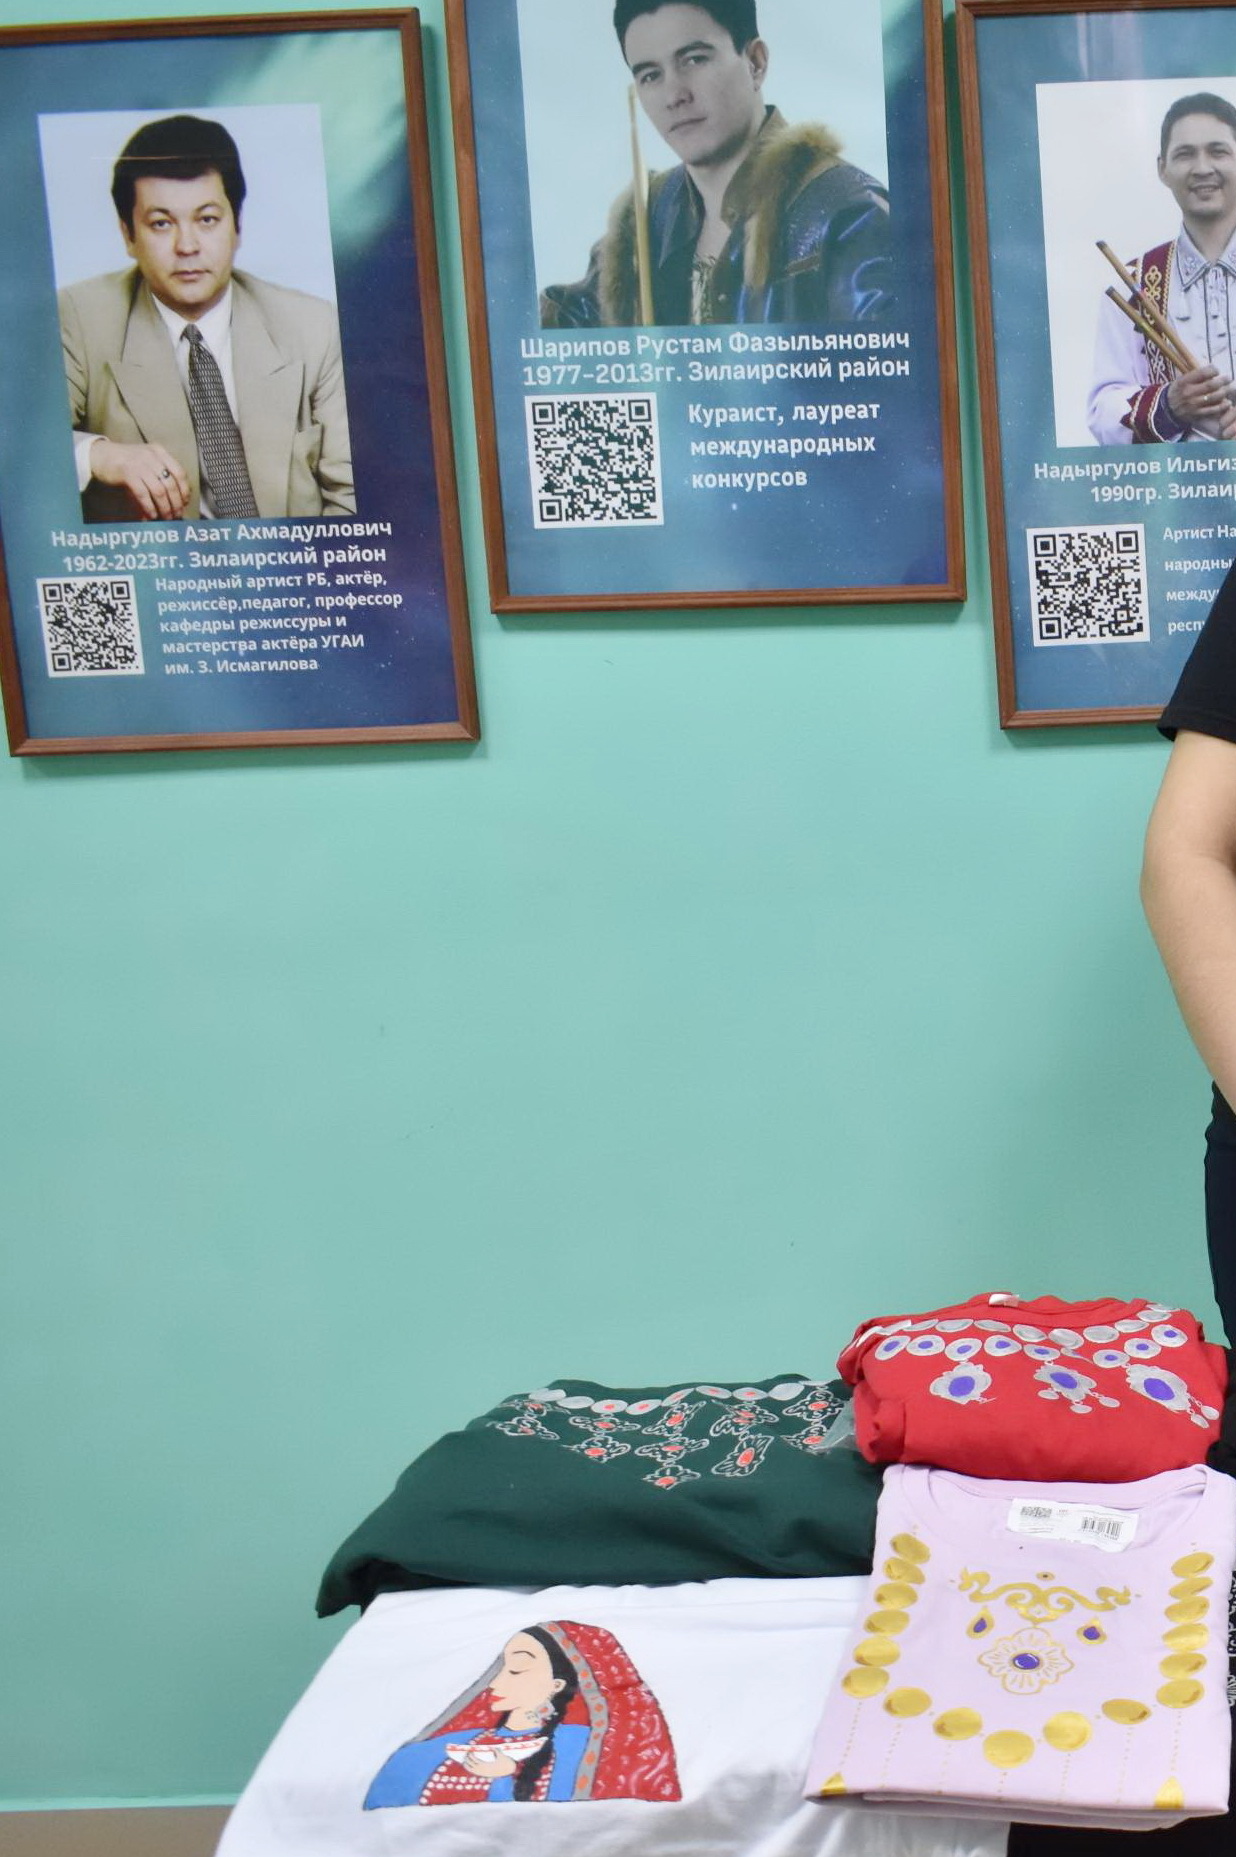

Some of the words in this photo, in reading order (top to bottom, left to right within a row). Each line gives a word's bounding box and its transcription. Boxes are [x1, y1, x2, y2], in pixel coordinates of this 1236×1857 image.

[520, 337, 631, 362] Шарипов
[637, 335, 722, 360] Рустам
[729, 331, 910, 356] Фазыльянович
[688, 357, 832, 384] Зилаирский
[838, 358, 910, 382] район
[688, 403, 784, 428] Кураист,
[792, 402, 881, 425] лауреат
[690, 435, 876, 459] международных
[692, 469, 808, 493] конкурсов
[1034, 460, 1162, 481] Надыргулов
[1090, 485, 1162, 505] 1990гр.
[51, 529, 180, 550] Надыргулов
[184, 526, 232, 543] Азат
[237, 522, 392, 543] Ахмадуллович
[1163, 527, 1215, 543] Артист
[62, 553, 184, 573] 1962-2023гг.
[189, 546, 318, 571] Зилаирский
[323, 546, 387, 568] район
[1164, 558, 1233, 574] народны
[155, 574, 242, 593] Народный
[246, 576, 303, 592] артист
[307, 573, 331, 588] РБ,
[335, 570, 387, 588] актёр,
[314, 592, 403, 611] профессор
[1166, 588, 1219, 603] между
[159, 618, 236, 635] кафедры
[239, 615, 332, 633] режиссуры
[335, 616, 347, 627] и
[1167, 620, 1204, 635] респ
[162, 639, 258, 656] мастерства
[261, 636, 318, 653] актёра
[321, 634, 365, 649] УГАИ
[164, 663, 194, 675] им.
[217, 658, 319, 673] Исмагилова
